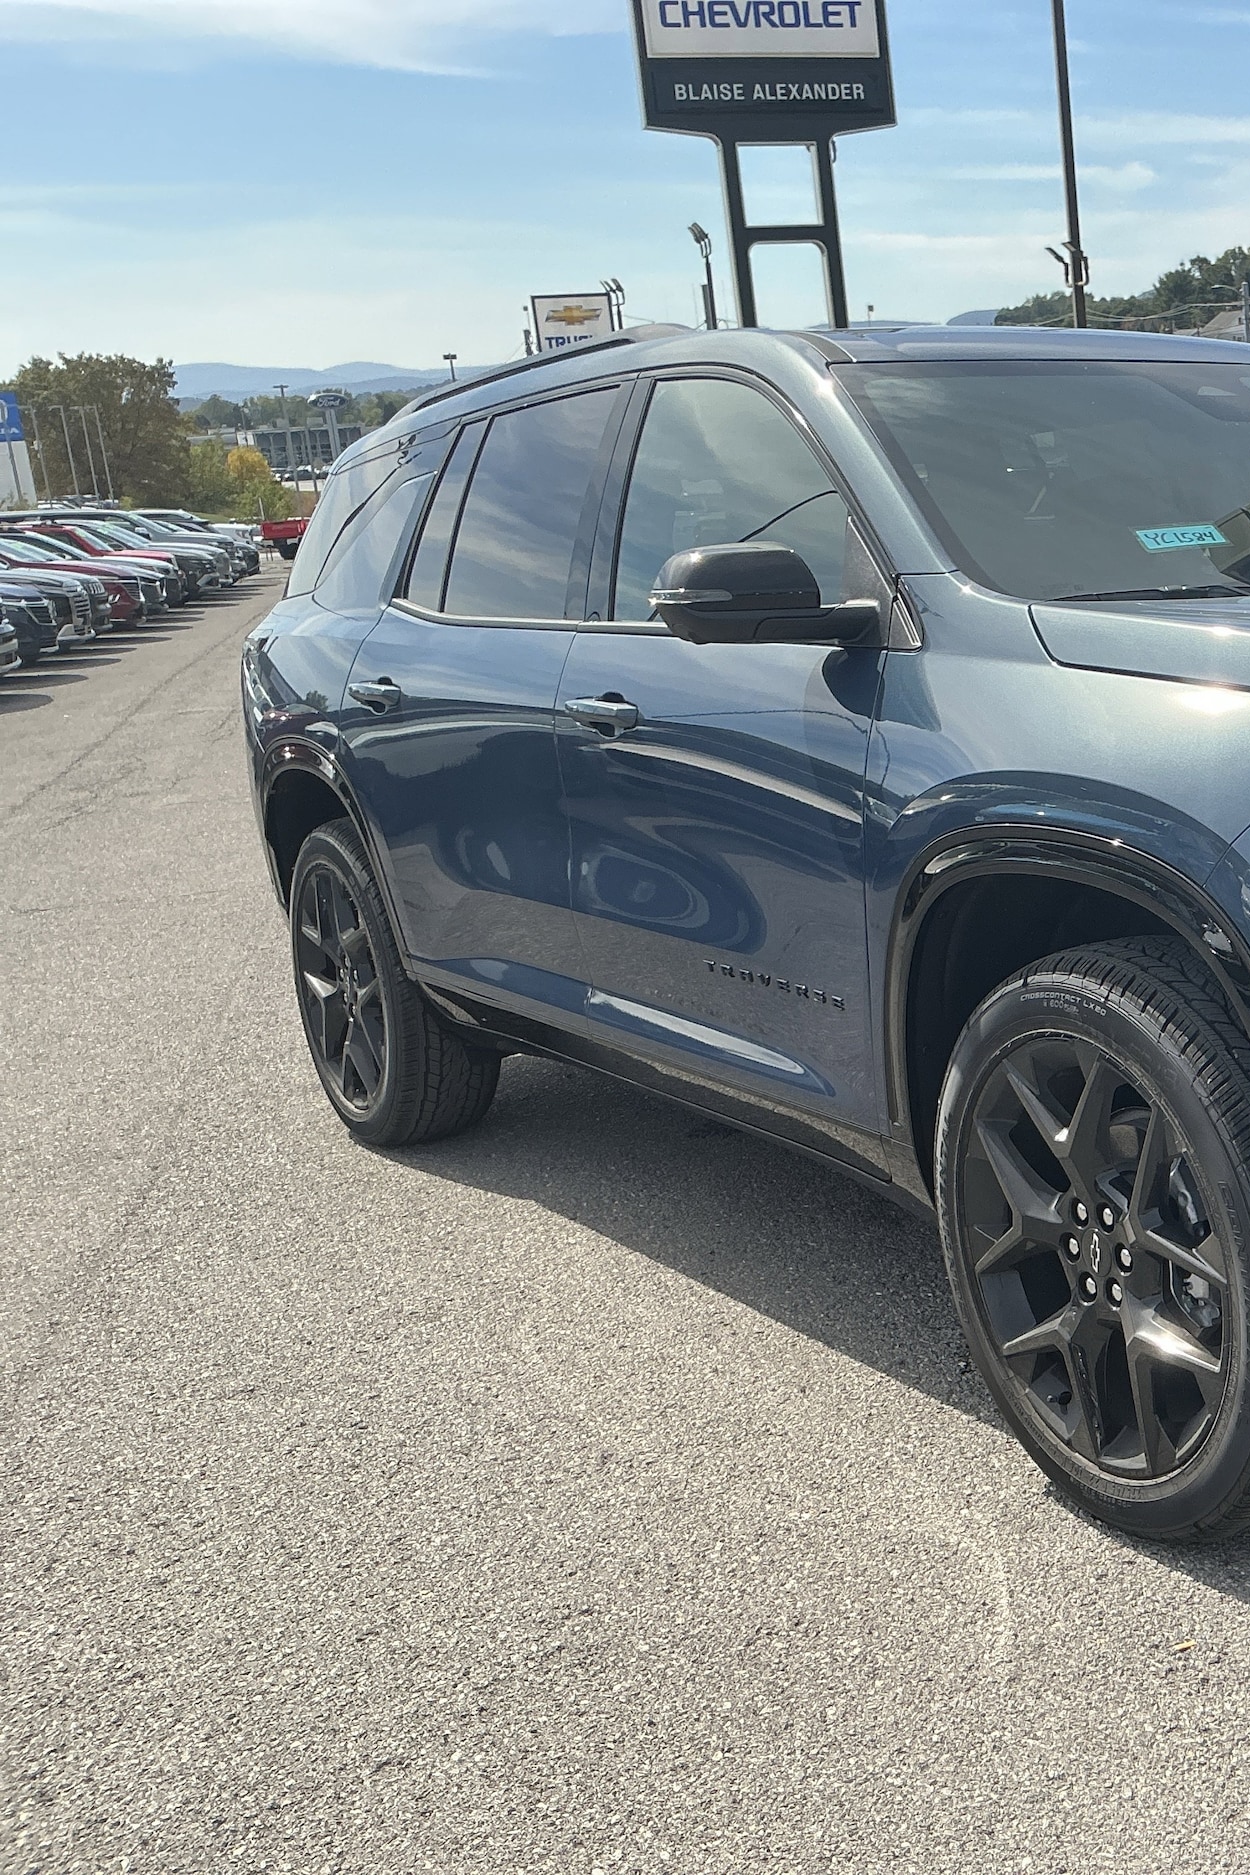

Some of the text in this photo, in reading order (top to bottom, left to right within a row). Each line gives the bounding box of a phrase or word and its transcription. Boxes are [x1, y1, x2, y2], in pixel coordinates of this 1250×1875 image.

[659, 1, 861, 27] CHEVROLET
[674, 83, 865, 101] BLAISE ALEXANDER
[703, 959, 846, 1011] TRAVERSE
